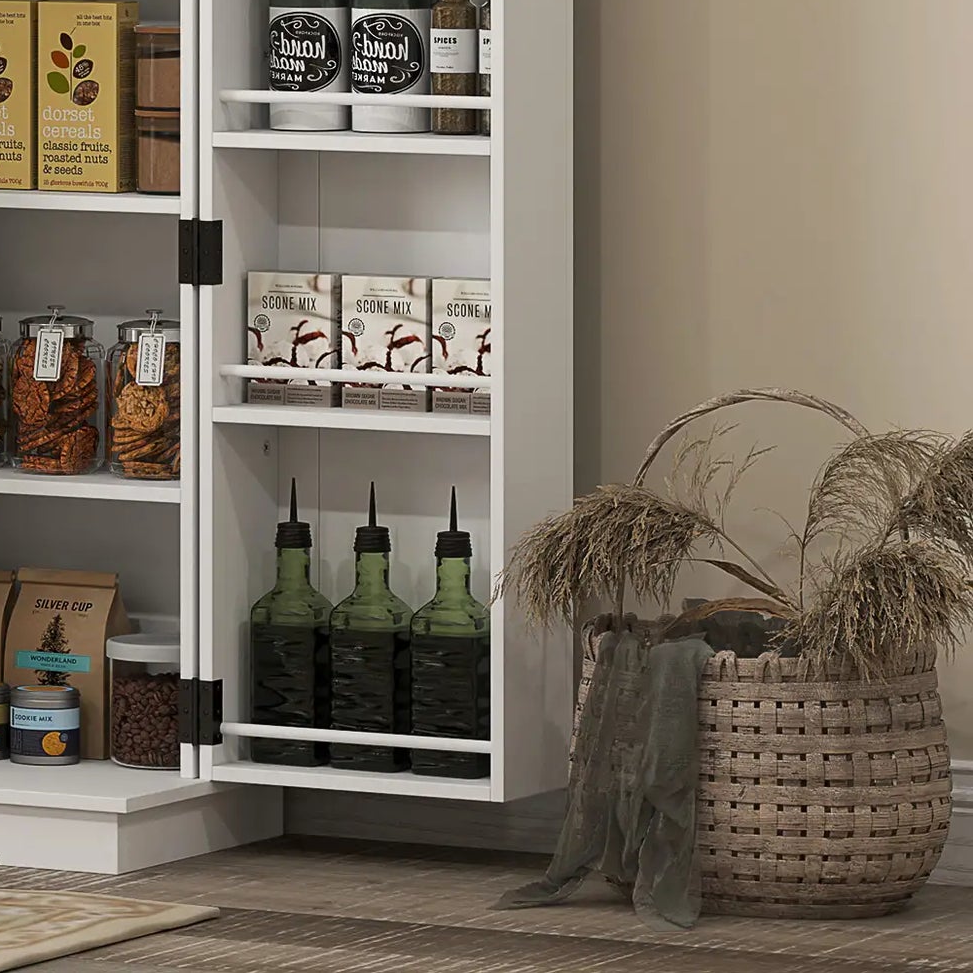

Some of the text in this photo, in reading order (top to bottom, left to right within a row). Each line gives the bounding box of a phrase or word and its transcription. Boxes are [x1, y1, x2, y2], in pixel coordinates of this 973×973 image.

[433, 36, 458, 44] SPICES
[42, 105, 95, 122] dorset
[42, 124, 101, 139] cereals
[43, 140, 112, 154] classic fruits,
[43, 153, 109, 164] roasted nuts
[43, 164, 83, 175] & seeds
[261, 295, 317, 311] SCONE MIX
[356, 299, 412, 315] SCONE MIX
[447, 302, 480, 318] SCONE
[34, 599, 93, 612] SILVER CUP
[30, 655, 77, 665] WONDERLAND
[14, 713, 38, 722] COOKIE
